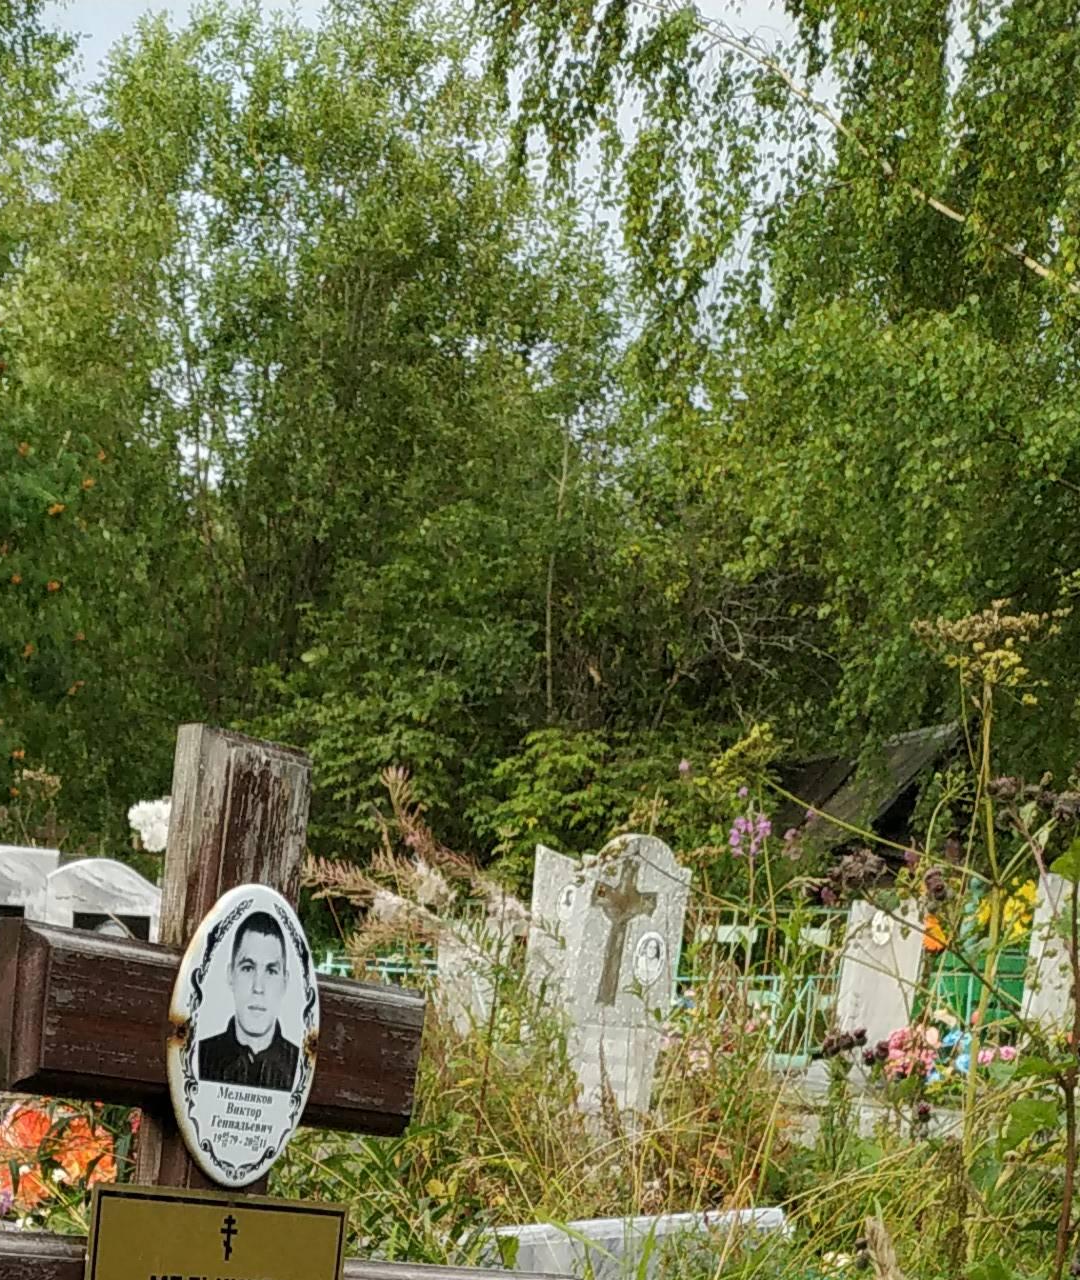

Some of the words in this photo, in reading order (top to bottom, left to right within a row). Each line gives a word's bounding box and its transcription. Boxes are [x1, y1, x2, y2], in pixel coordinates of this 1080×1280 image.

[217, 1086, 272, 1104] Мельников
[226, 1102, 262, 1120] Виктор
[211, 1115, 273, 1134] Геннадьевич
